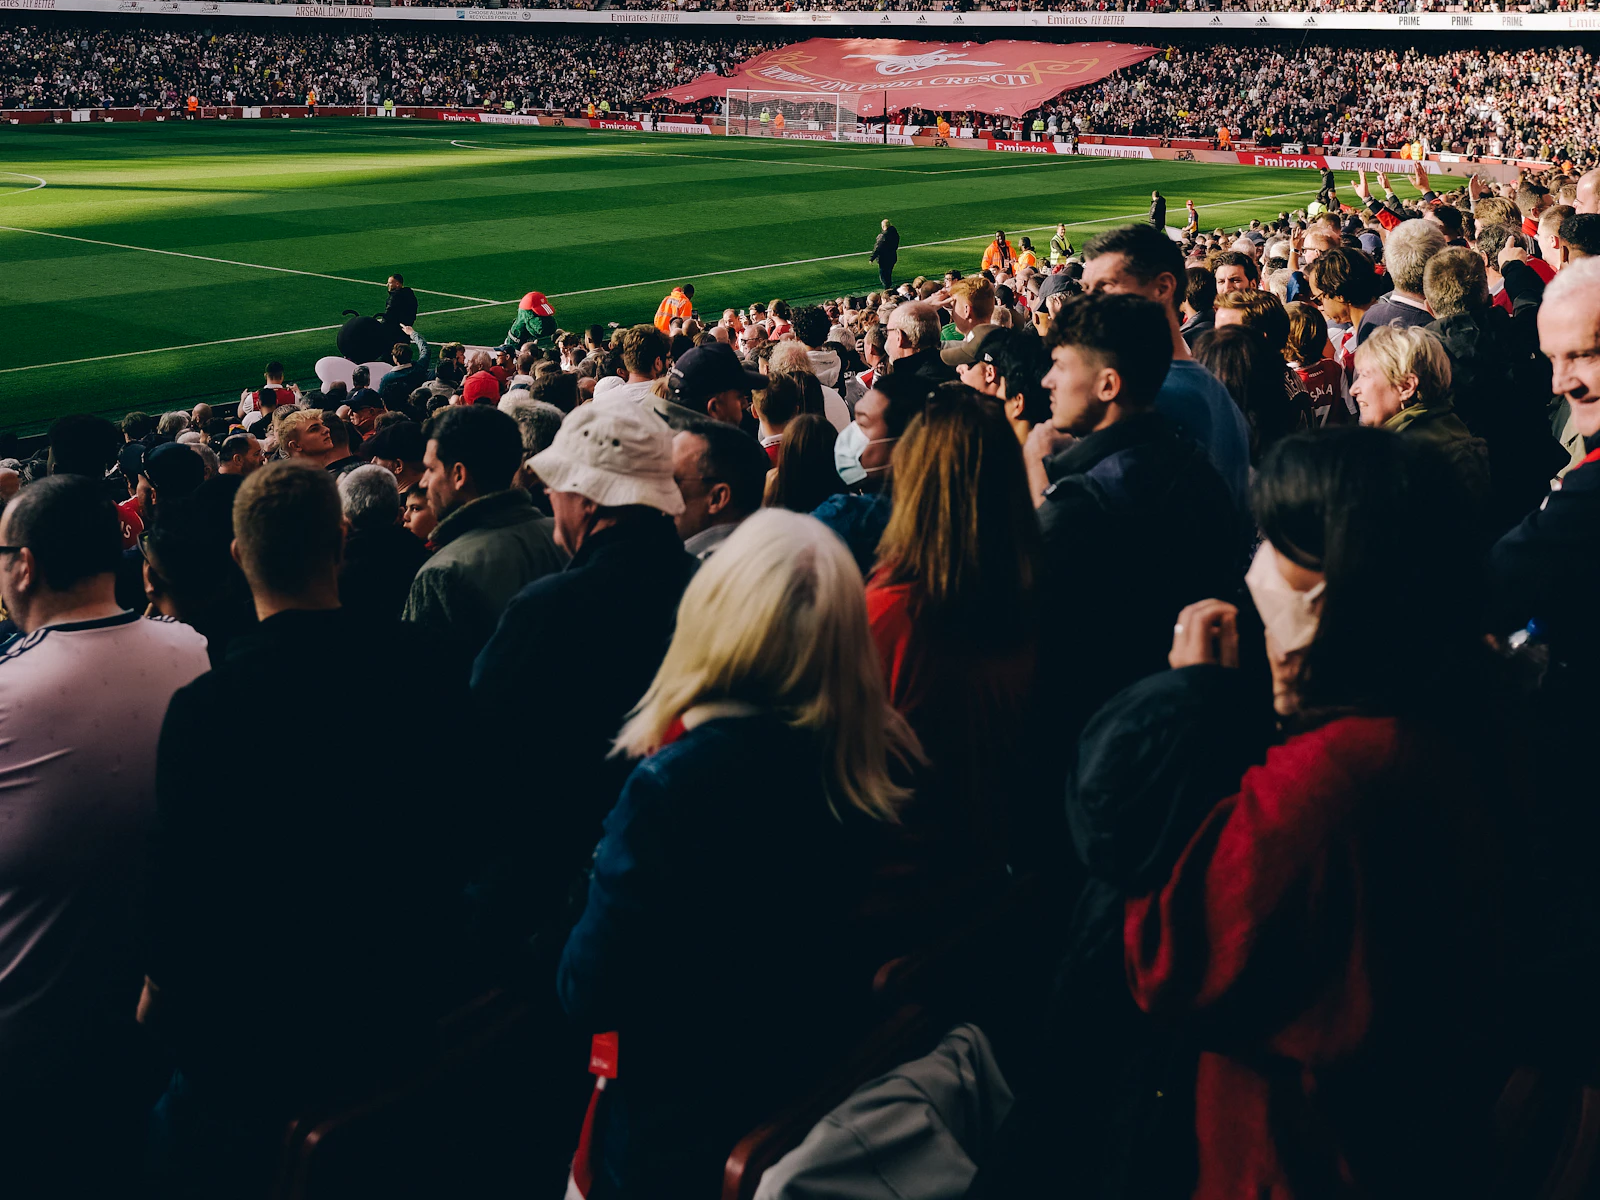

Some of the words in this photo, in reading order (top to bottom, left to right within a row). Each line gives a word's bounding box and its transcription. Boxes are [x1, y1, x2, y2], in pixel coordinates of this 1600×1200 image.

[22, 0, 34, 8] FLY
[34, 0, 56, 9] BETTER
[295, 6, 373, 18] ARSENAL.COM/TOURS
[611, 12, 648, 22] Emirates
[650, 13, 660, 22] FLY
[660, 13, 679, 23] BETTER
[1047, 14, 1088, 25] Emirates
[1090, 15, 1101, 25] FLY
[1102, 15, 1125, 26] BETTER
[1398, 16, 1421, 27] PRIME
[1451, 16, 1474, 27] PRIME
[1502, 16, 1524, 27] PRIME
[929, 73, 1030, 86] CRESCIT
[599, 120, 637, 131] Emirates
[782, 131, 828, 141] Emirates
[995, 142, 1048, 153] Emirates
[1080, 148, 1093, 156] YOU
[1093, 148, 1113, 157] SOON
[1113, 149, 1121, 158] IN
[1254, 155, 1318, 169] Emirates
[1340, 161, 1355, 170] SEE
[1374, 162, 1395, 173] SOON
[1397, 164, 1406, 173] IN
